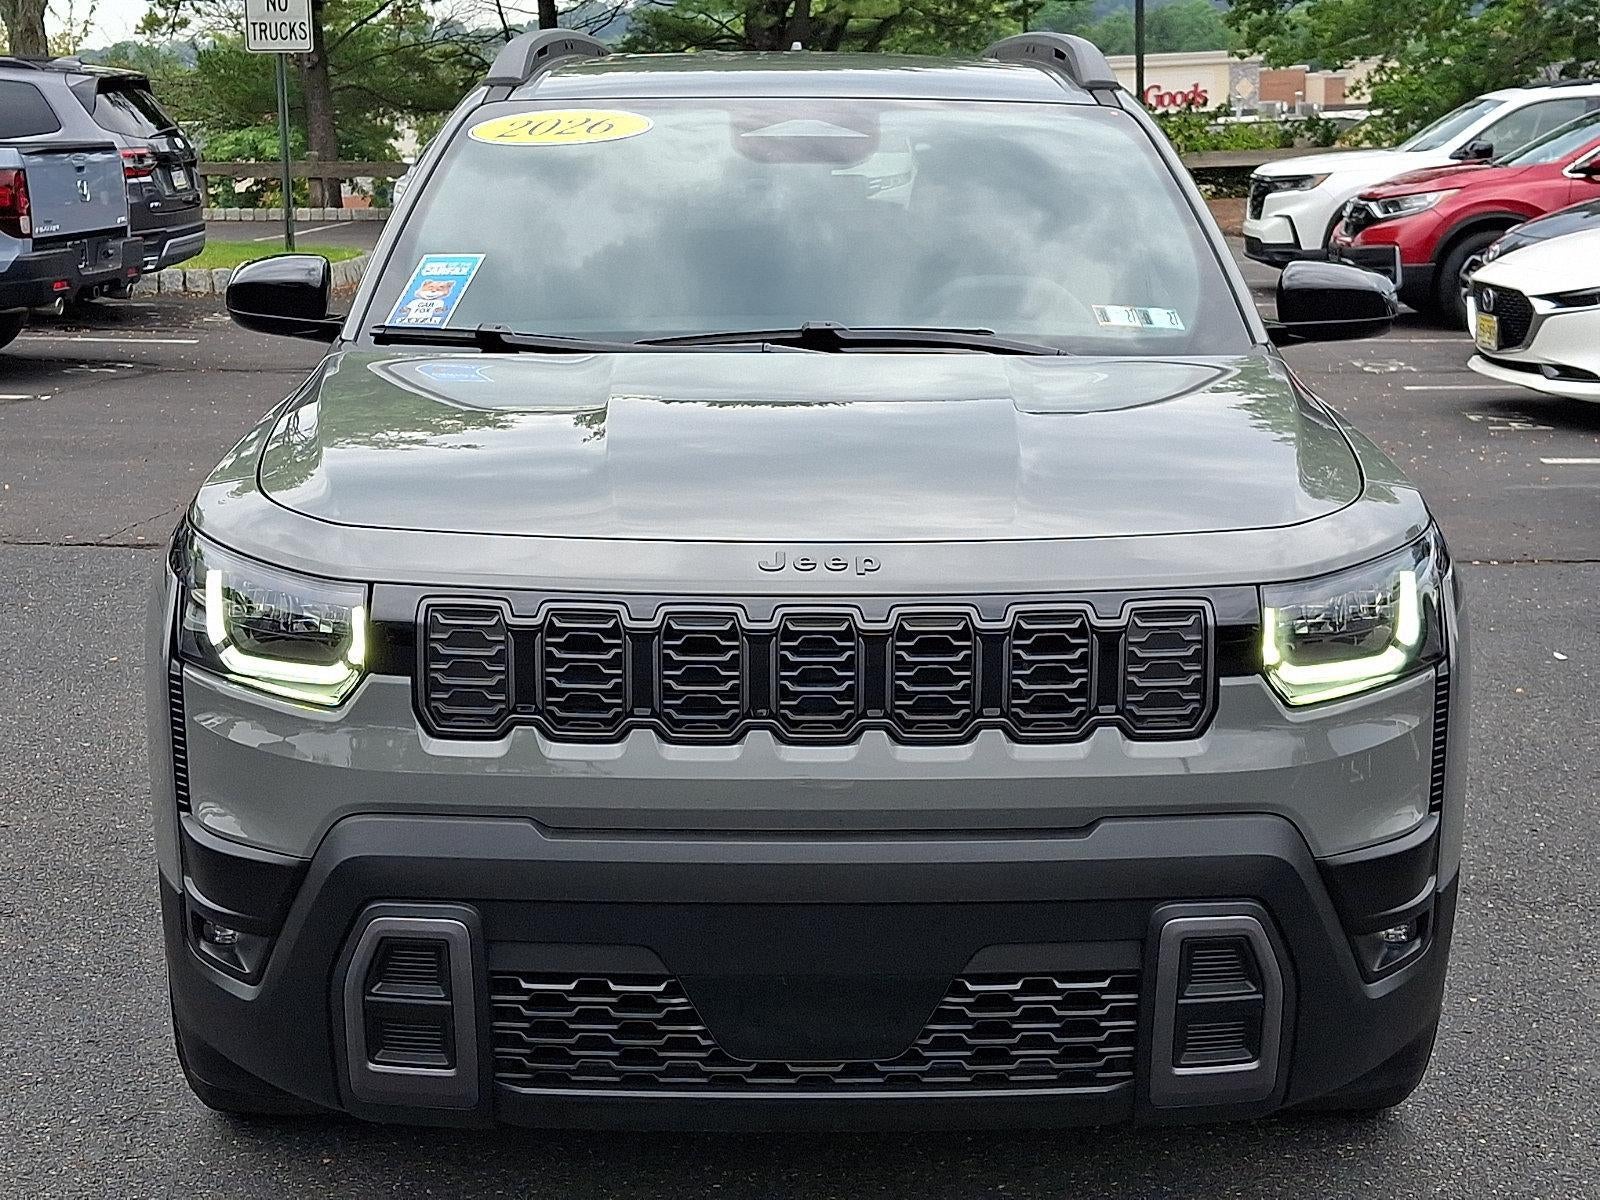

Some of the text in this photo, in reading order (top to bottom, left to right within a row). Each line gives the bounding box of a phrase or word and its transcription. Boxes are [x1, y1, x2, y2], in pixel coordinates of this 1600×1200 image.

[266, 0, 288, 12] NO
[250, 21, 308, 41] TRUCKS
[1143, 82, 1209, 108] Goods
[496, 117, 614, 138] 2026
[758, 551, 881, 576] Jeep
